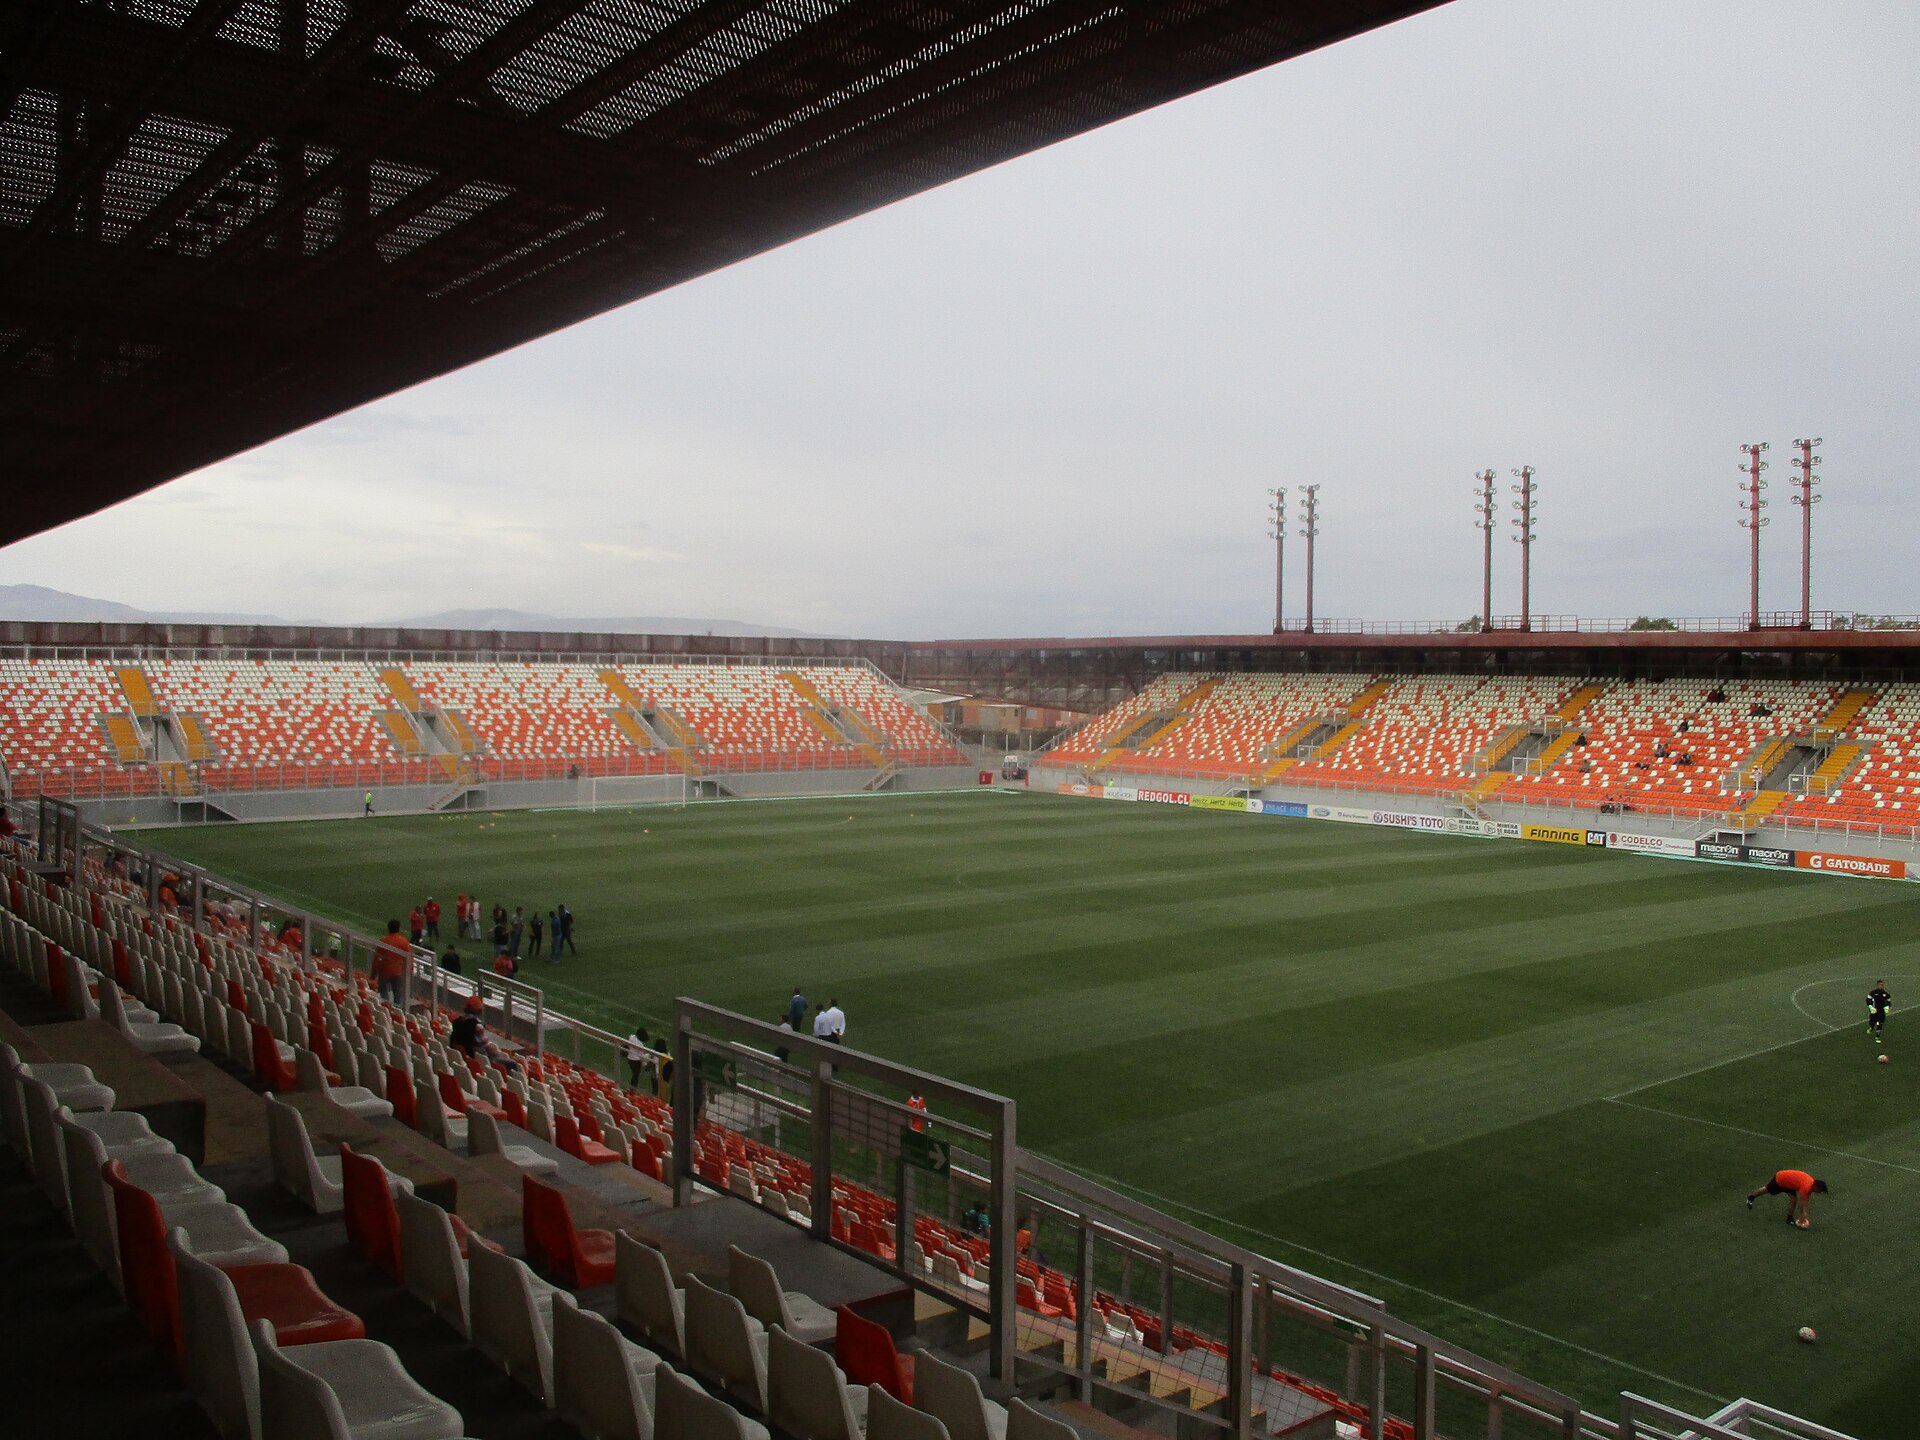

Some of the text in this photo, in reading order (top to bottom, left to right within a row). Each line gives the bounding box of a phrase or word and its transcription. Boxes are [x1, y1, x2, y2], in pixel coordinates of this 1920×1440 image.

[1138, 790, 1189, 805] REDGOL.CL
[1383, 813, 1418, 826] SUSHI'S
[1420, 817, 1444, 829] TOTO
[1530, 828, 1580, 842] FINNING
[1587, 832, 1605, 845] CAT
[1621, 835, 1663, 847] CODELCO
[1700, 843, 1740, 855] macron
[1748, 848, 1789, 860] macron
[1825, 858, 1890, 874] GATORADE
